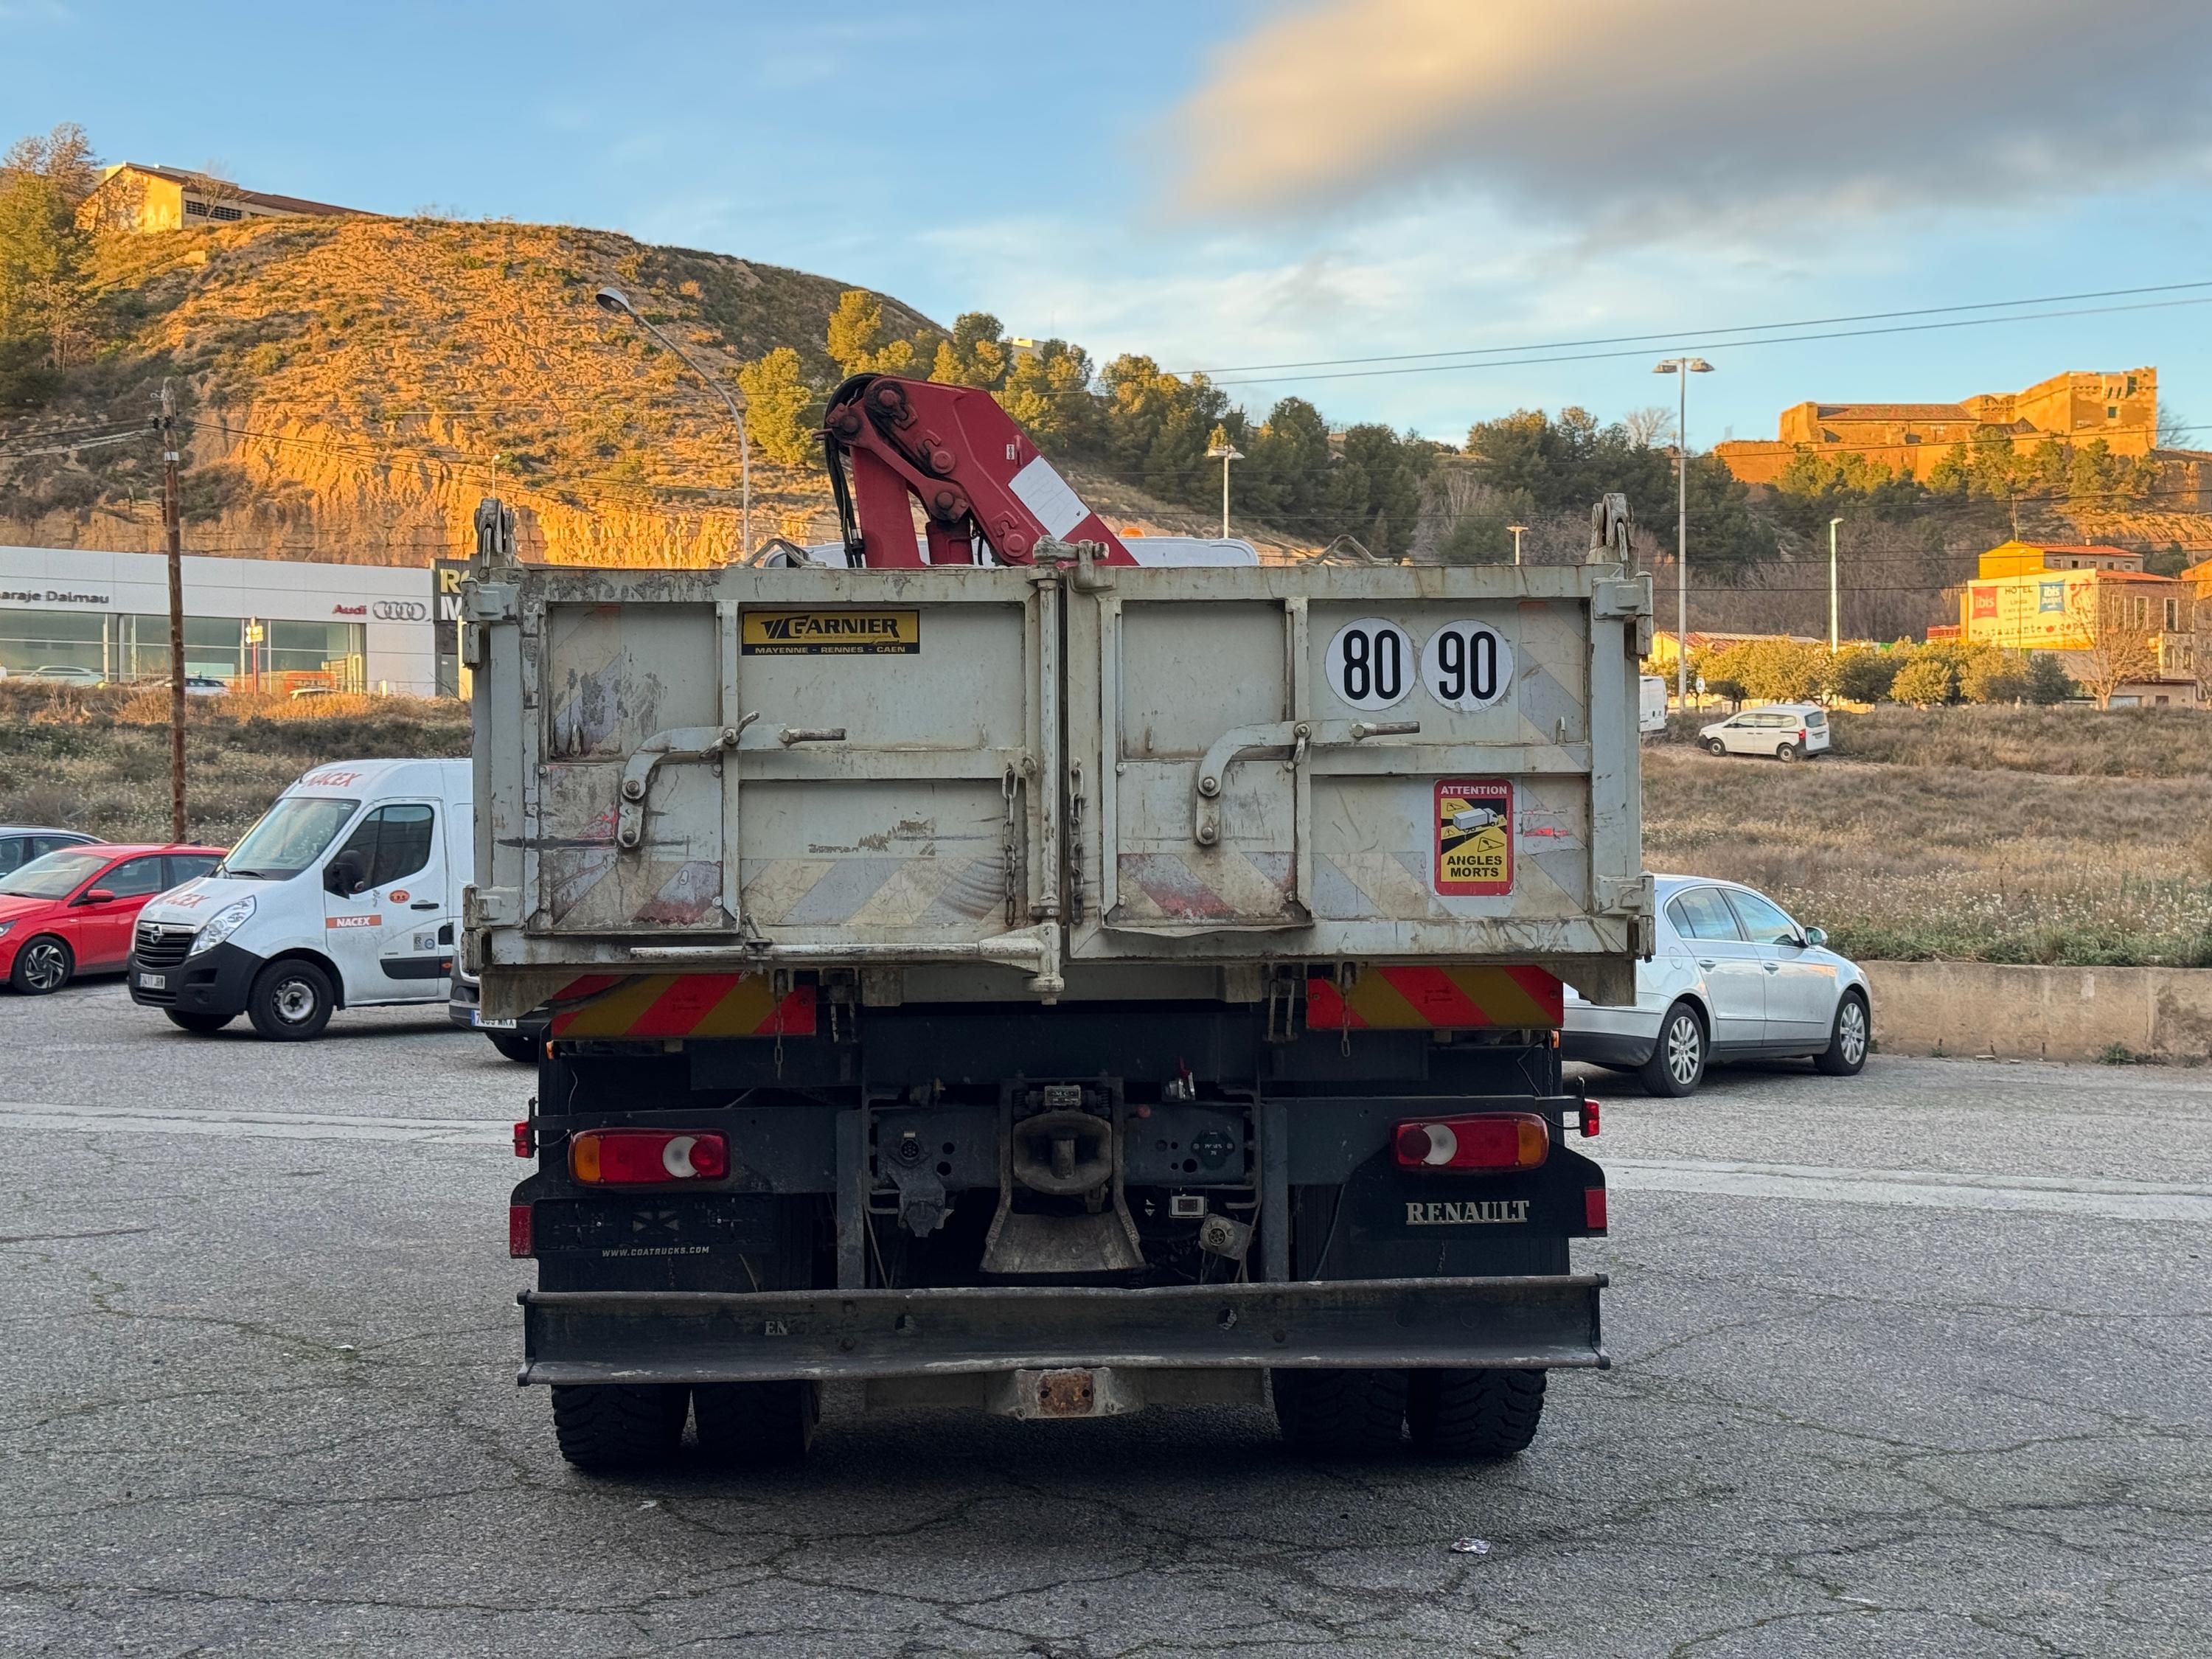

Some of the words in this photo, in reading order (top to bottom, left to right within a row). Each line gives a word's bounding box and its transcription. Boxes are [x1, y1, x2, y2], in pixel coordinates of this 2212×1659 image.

[0, 590, 41, 602] araje
[46, 591, 109, 604] Dalmau
[2044, 586, 2060, 597] ibis
[1975, 596, 1994, 609] ibis
[333, 604, 366, 615] Audi
[788, 617, 900, 639] GARNIER
[755, 647, 808, 655] MAYENNE
[1343, 630, 1401, 700] 80
[1439, 631, 1497, 700] 90
[1441, 786, 1507, 795] ATTENTION
[1447, 855, 1502, 866] ANGLES
[1451, 867, 1499, 877] MORTS
[336, 917, 370, 927] NACEX
[1405, 1200, 1529, 1224] RENAULT
[602, 1246, 709, 1257] WWW.COATRUCKS.COM
